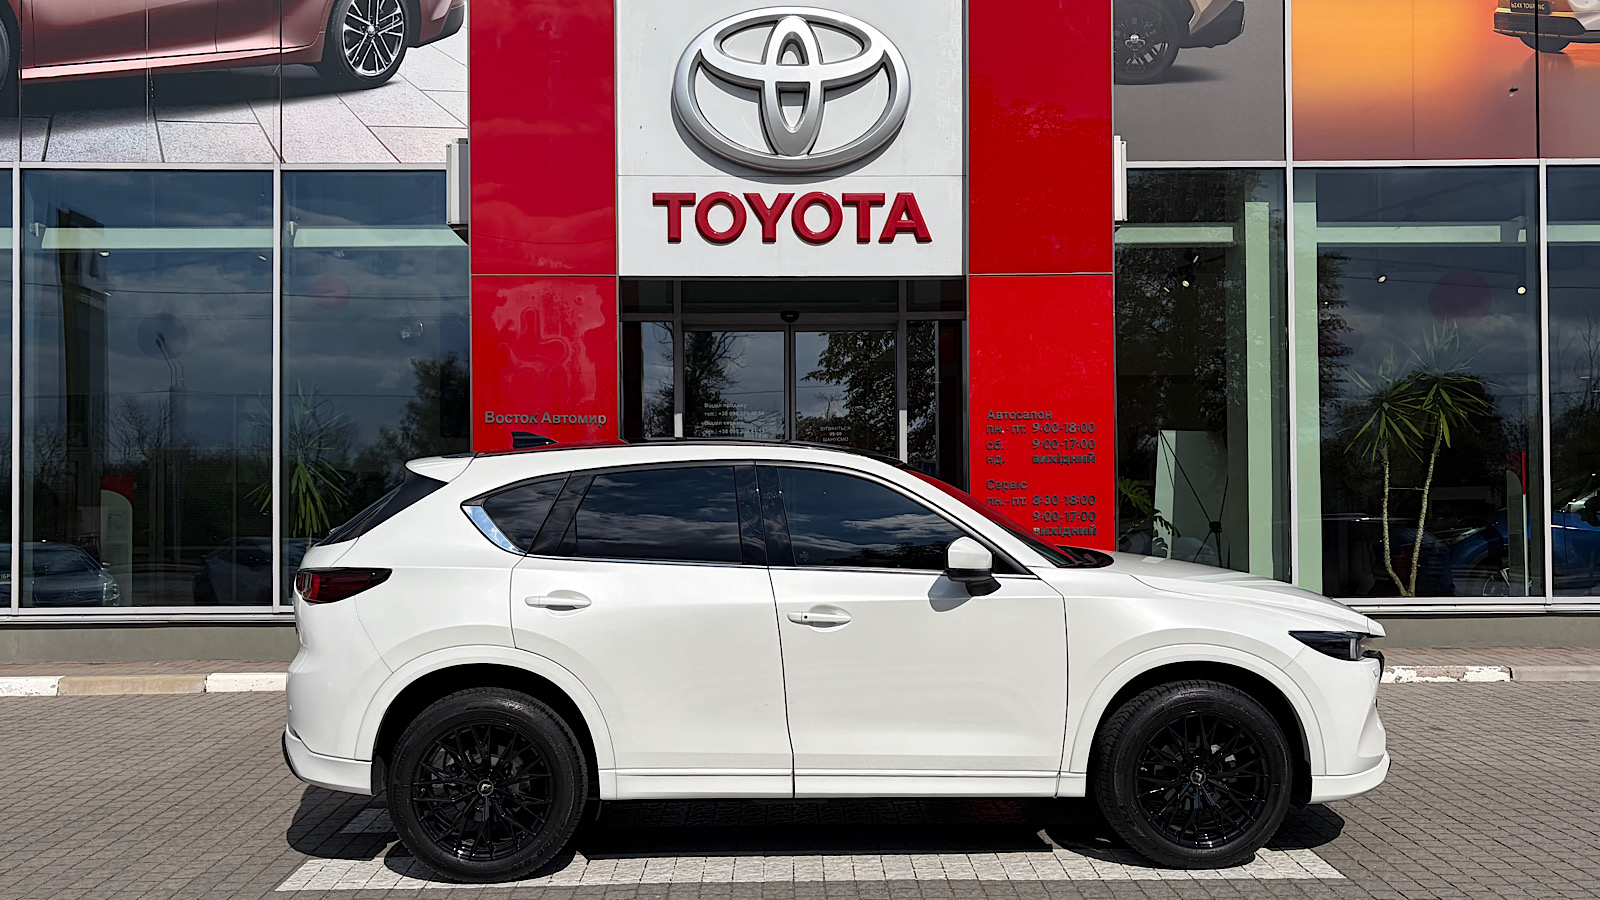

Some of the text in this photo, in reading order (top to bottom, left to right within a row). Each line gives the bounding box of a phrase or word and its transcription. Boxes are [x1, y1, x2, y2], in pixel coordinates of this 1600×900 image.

[1523, 2, 1545, 10] TOURNG
[652, 191, 932, 245] TOYOTA
[484, 411, 607, 428] Восток Автомир
[986, 409, 1052, 420] Автосалон
[1032, 422, 1096, 434] 9:00-18:00
[986, 439, 1096, 450] сб. 9:00-17:00
[986, 452, 1096, 465] нд. вихідний
[986, 479, 1028, 492] Сервіс
[1032, 511, 1097, 522] 9:00-17:00
